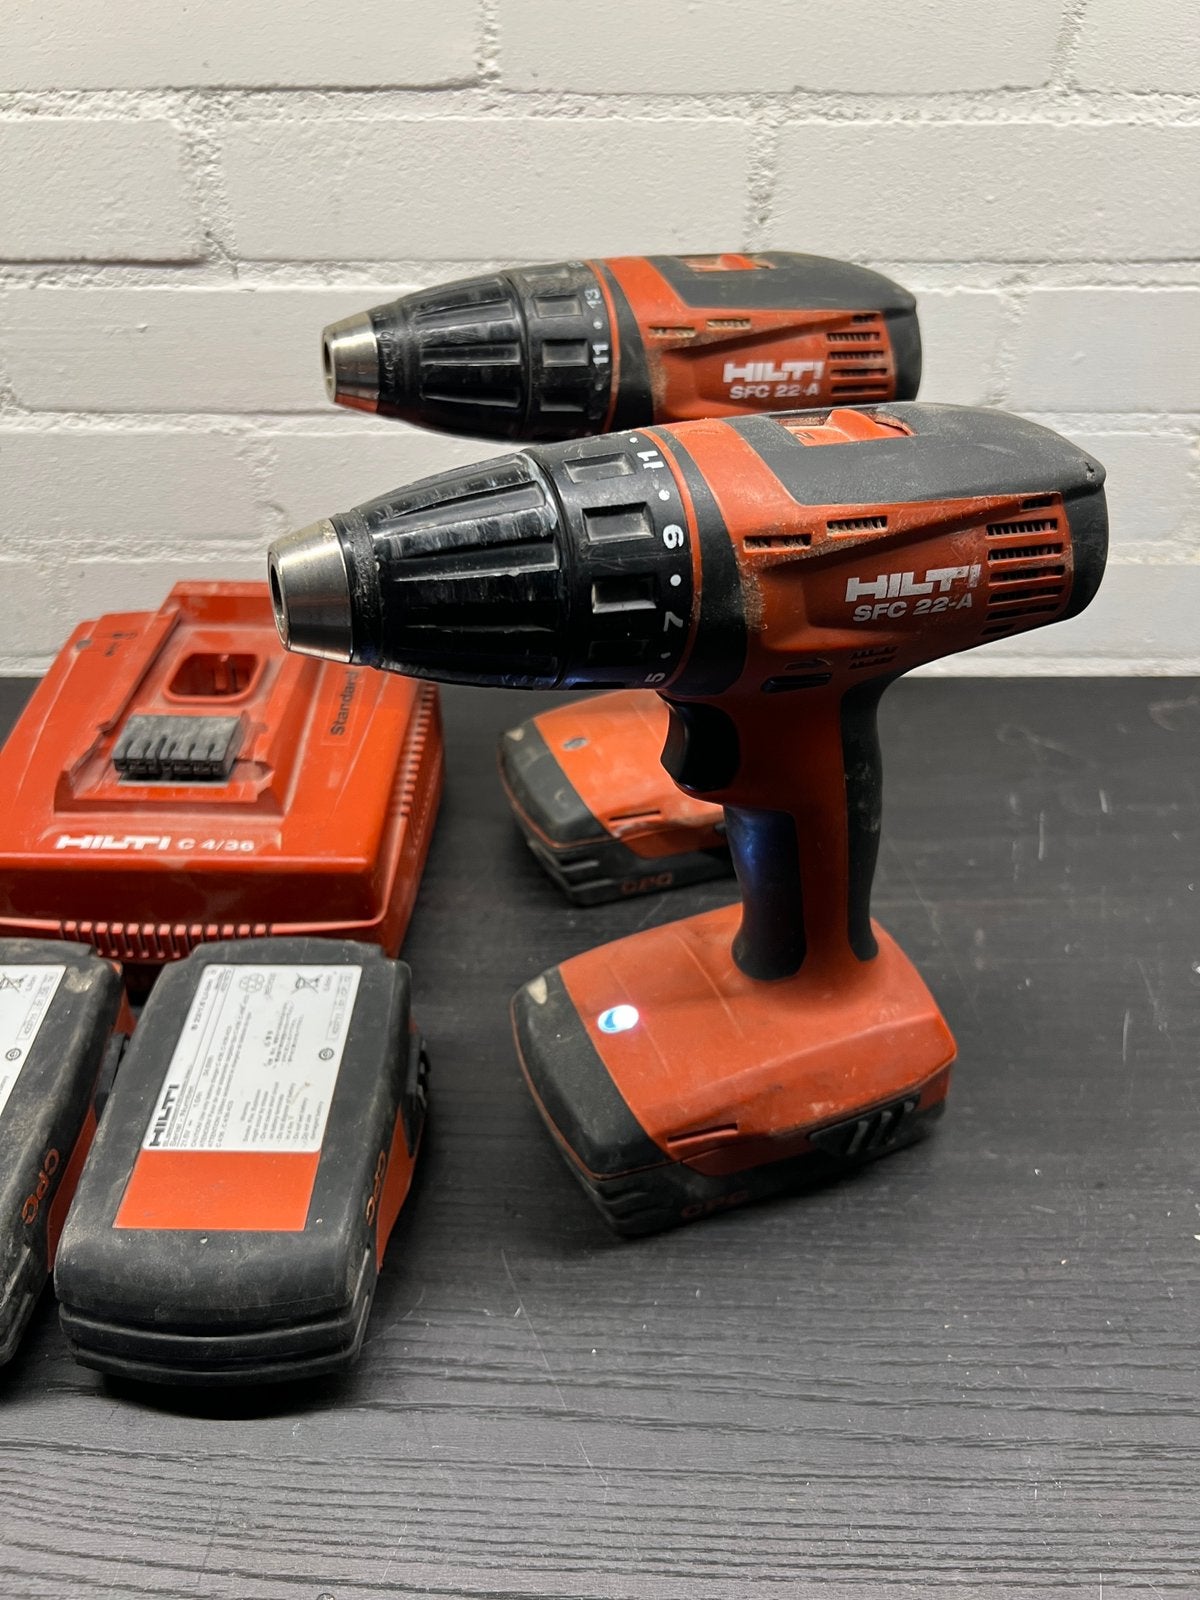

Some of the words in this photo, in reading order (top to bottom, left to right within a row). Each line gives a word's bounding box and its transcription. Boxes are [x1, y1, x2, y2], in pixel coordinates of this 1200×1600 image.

[584, 288, 602, 309] 13
[592, 343, 609, 365] 11
[723, 360, 826, 384] HILTI
[729, 385, 770, 400] SFC
[636, 449, 664, 470] 11
[844, 564, 982, 603] HILTI
[852, 602, 907, 623] SFC
[912, 596, 974, 616] 22-A
[663, 611, 684, 632] 7
[329, 670, 361, 736] Standard
[54, 835, 172, 850] HILTI
[177, 838, 195, 850] C
[200, 838, 255, 852] 4/36
[148, 1084, 179, 1146] HILTI
[21, 1148, 60, 1225] CPC
